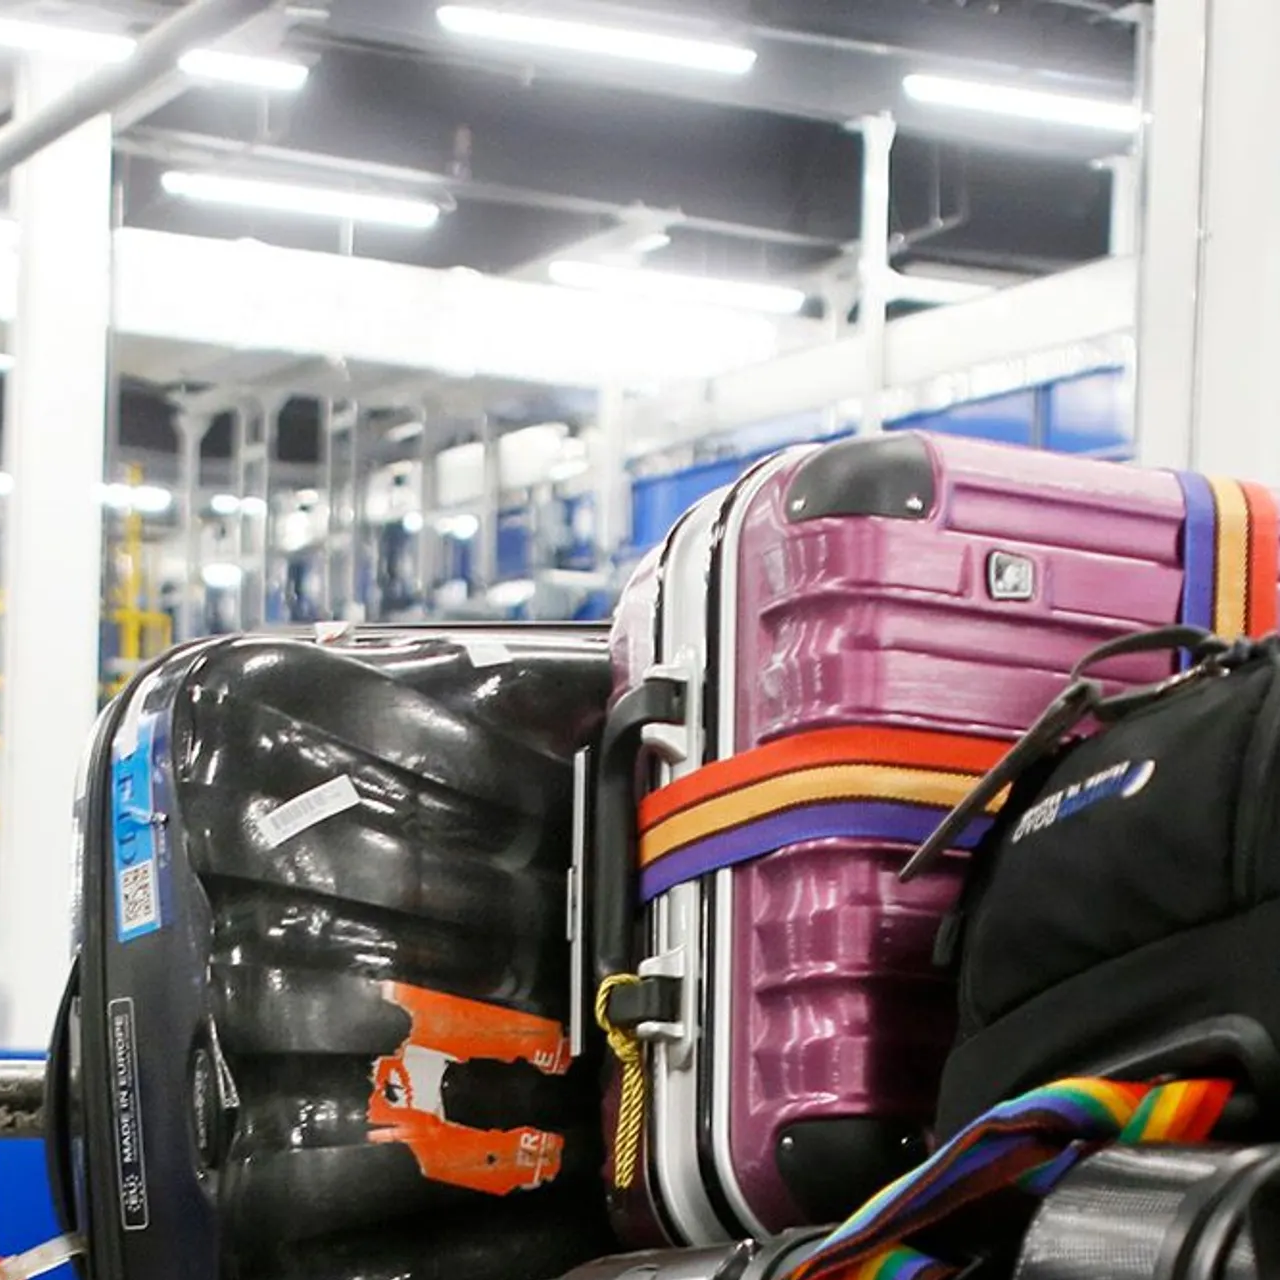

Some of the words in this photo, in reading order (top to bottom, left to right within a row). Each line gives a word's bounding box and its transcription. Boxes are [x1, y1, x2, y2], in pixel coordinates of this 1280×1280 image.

[113, 1013, 127, 1086] EUROPE
[118, 1089, 129, 1108] IN
[120, 1111, 134, 1164] MADE
